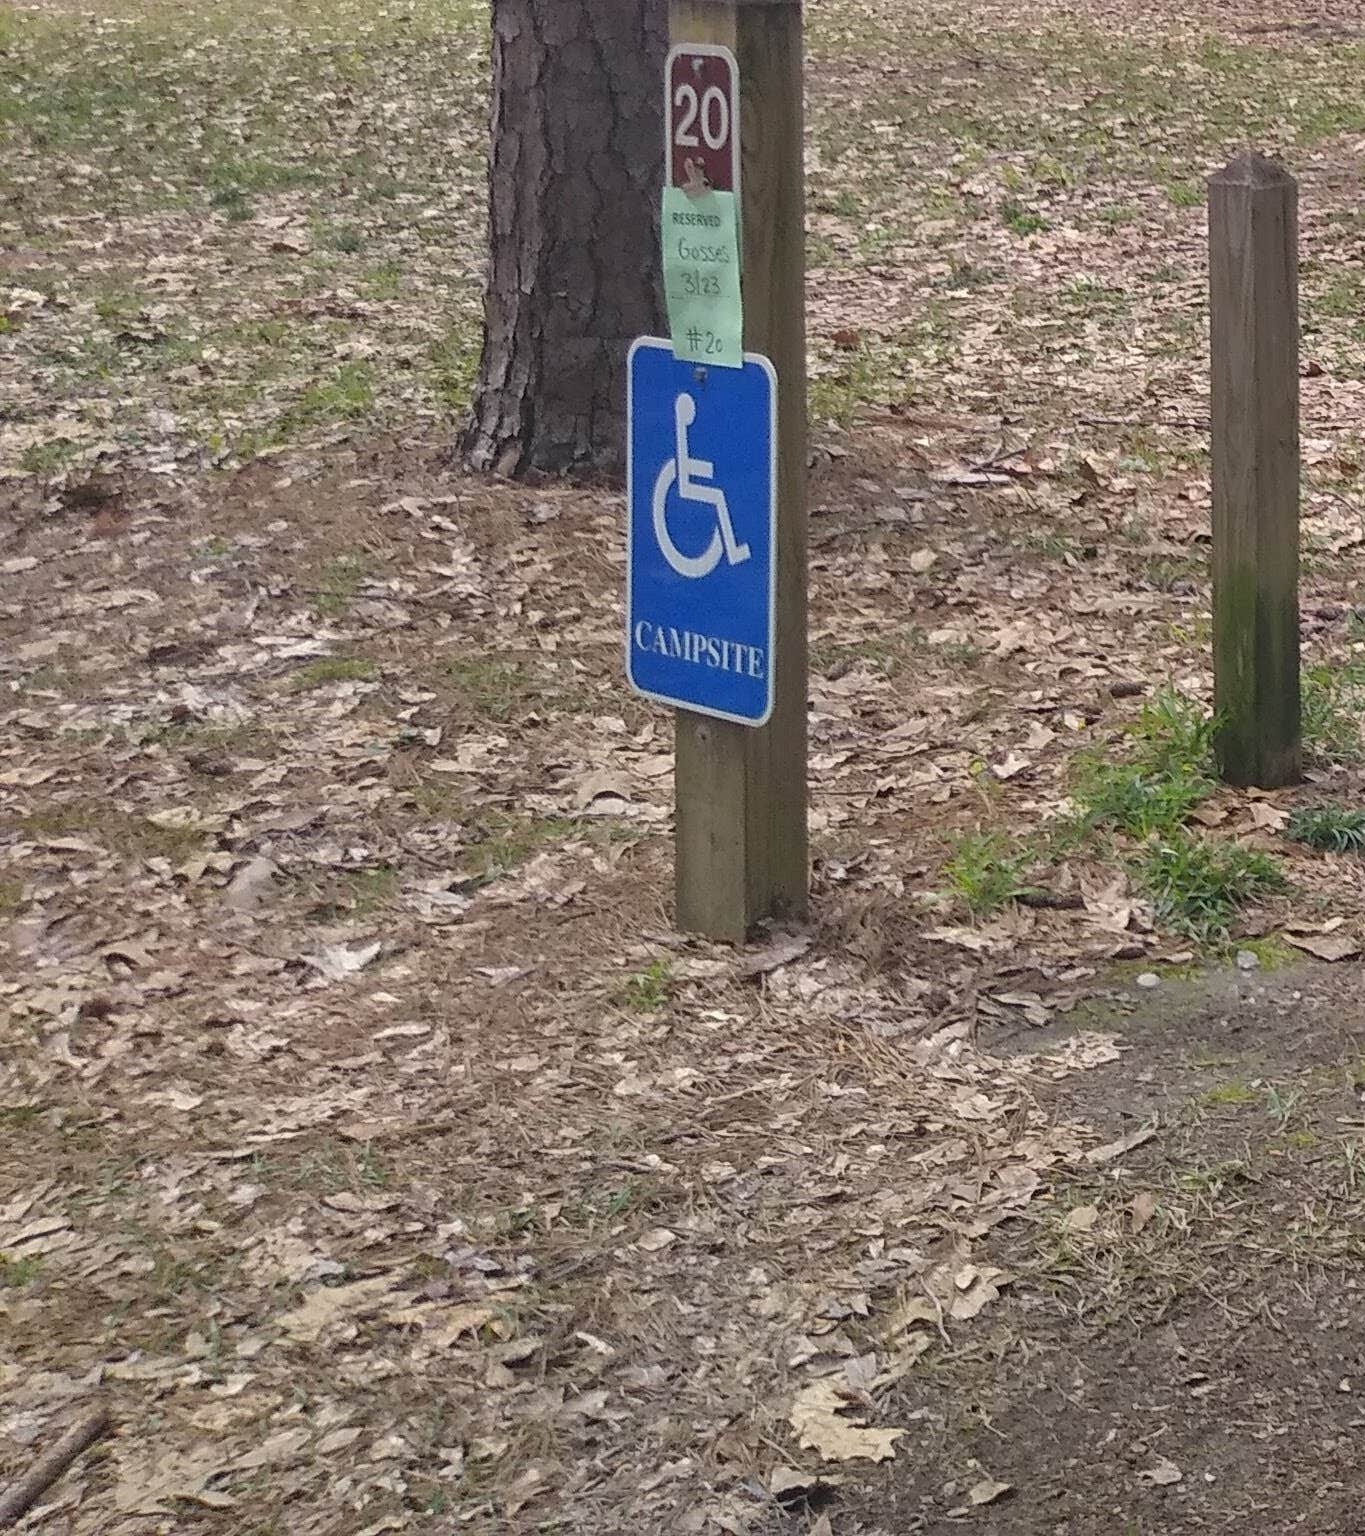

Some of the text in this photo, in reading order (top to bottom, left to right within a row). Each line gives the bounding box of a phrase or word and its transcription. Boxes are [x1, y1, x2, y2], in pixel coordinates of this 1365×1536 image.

[675, 84, 729, 150] 20
[672, 212, 721, 228] RESERVED
[681, 268, 721, 296] 3/23
[686, 325, 724, 355] #20
[635, 620, 764, 679] CAMPSITE
